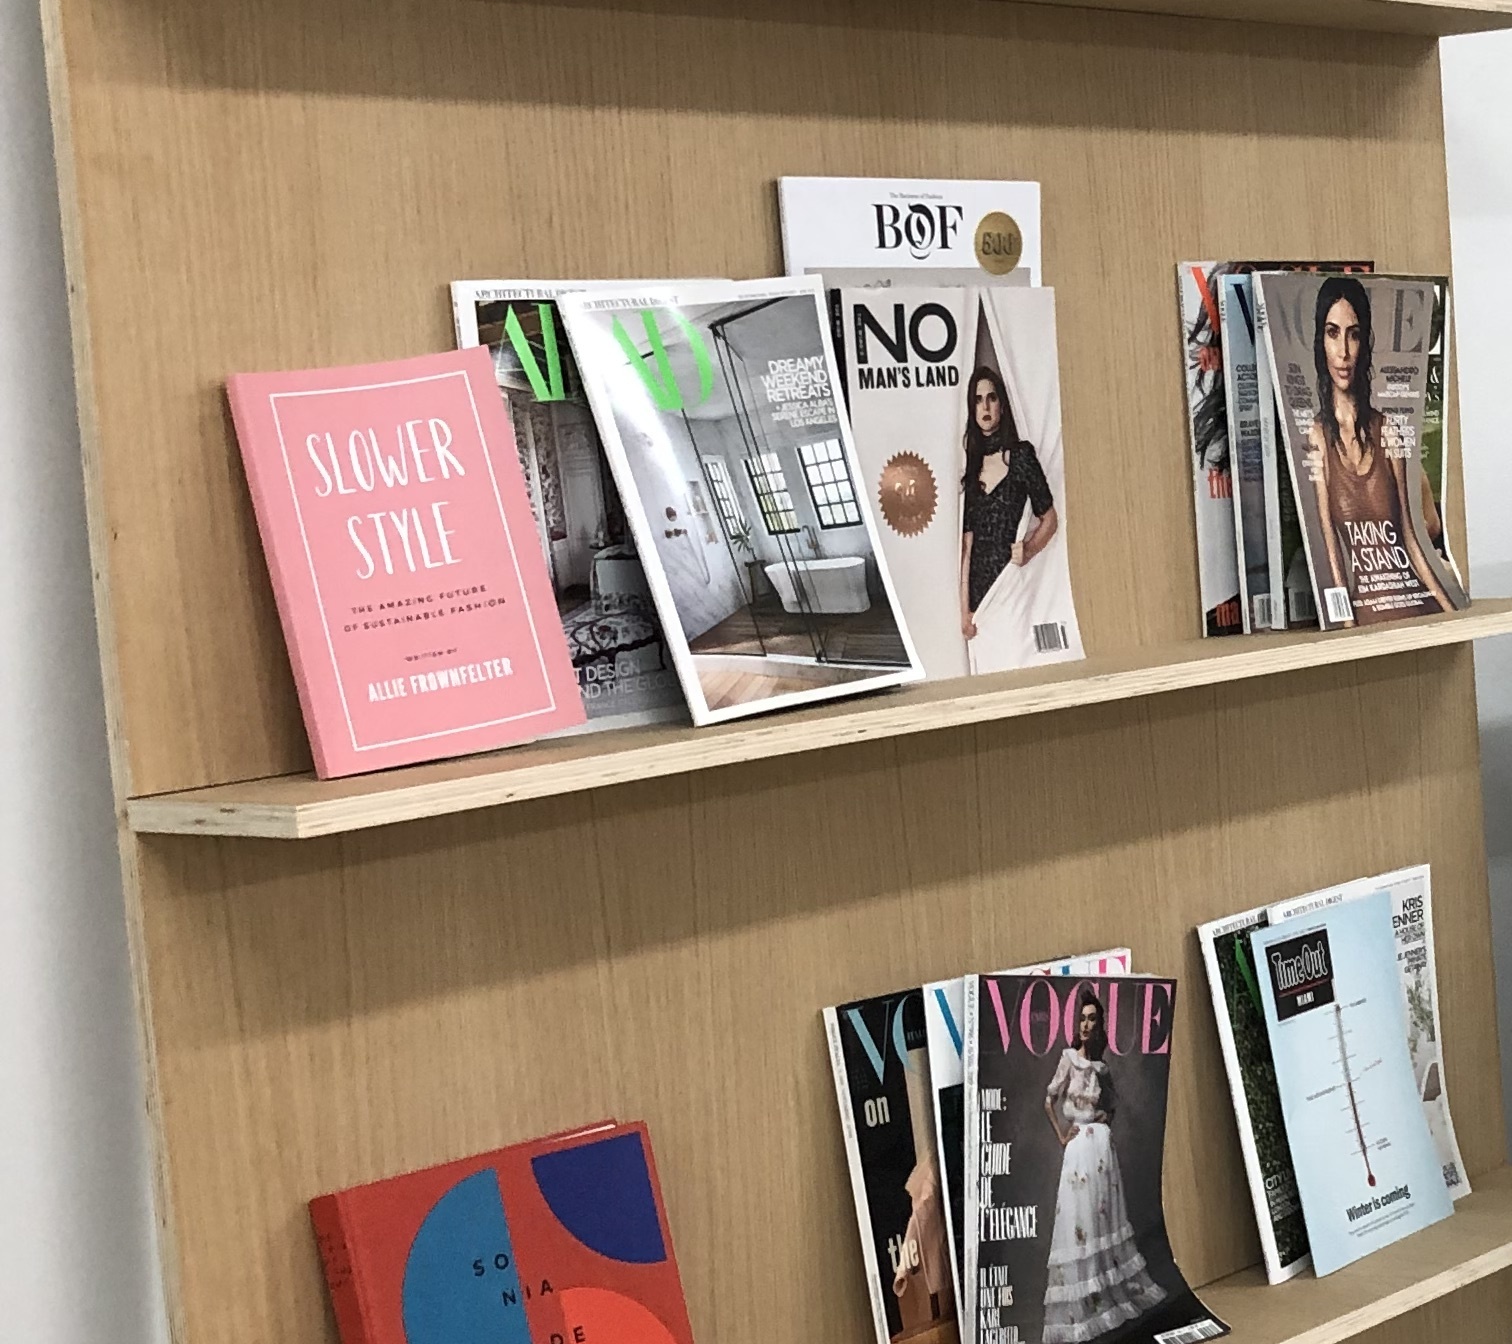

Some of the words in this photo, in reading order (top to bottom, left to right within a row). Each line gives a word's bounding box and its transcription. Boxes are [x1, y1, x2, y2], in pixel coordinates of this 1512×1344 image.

[853, 302, 958, 365] NO
[760, 370, 828, 389] WEEKEND
[767, 355, 824, 375] DREAMY
[858, 365, 911, 391] MAN'S
[915, 365, 960, 388] LAND
[766, 384, 831, 404] RETREATS
[1387, 436, 1416, 447] WOMEN
[305, 418, 466, 498] SLOWER
[346, 501, 463, 580] STYLE
[1344, 519, 1397, 546] TAKING
[1351, 548, 1363, 573] A
[1360, 546, 1411, 572] STAND
[343, 623, 359, 633] OF
[363, 608, 446, 631] SUSTAINABLE
[450, 597, 507, 615] FASHION
[351, 604, 373, 615] THE
[379, 594, 434, 611] AMAZING
[439, 584, 488, 600] FUTURE
[367, 676, 408, 703] ALLIE
[408, 656, 514, 695] FROWNFELTER
[586, 659, 641, 682] DESIGN
[1392, 909, 1424, 929] ENNER
[1402, 895, 1424, 912] KRIS
[1271, 951, 1304, 992] Time
[1302, 940, 1329, 981] Out
[983, 978, 1173, 1057] VOGUE
[864, 1096, 891, 1128] on
[980, 1111, 992, 1143] LE
[981, 1142, 1013, 1176] GUIDE
[980, 1176, 993, 1207] DE
[1345, 1201, 1373, 1223] Winter
[1372, 1196, 1382, 1210] is
[1381, 1184, 1412, 1207] coming
[472, 1253, 510, 1277] SO
[887, 1233, 920, 1274] the
[502, 1279, 554, 1306] NIA
